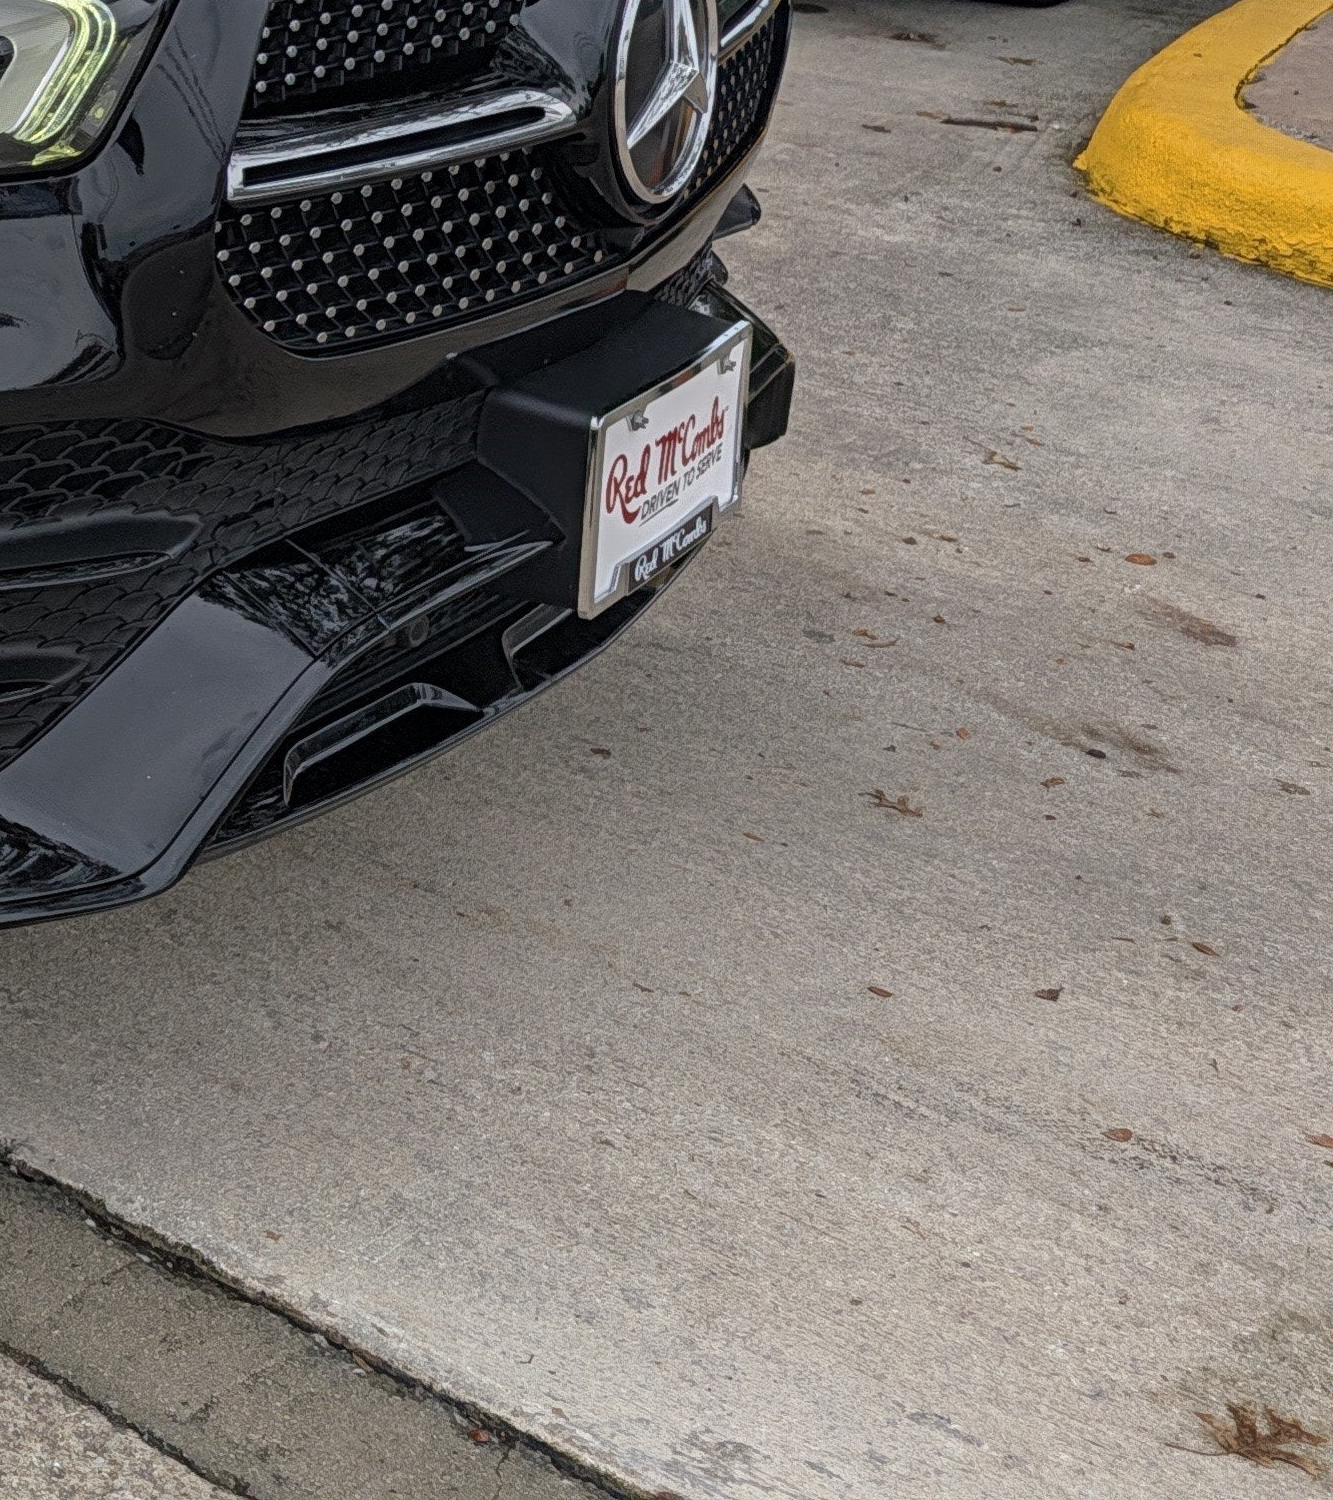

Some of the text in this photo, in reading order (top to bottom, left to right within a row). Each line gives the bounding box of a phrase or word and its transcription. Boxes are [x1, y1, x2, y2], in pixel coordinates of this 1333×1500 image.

[605, 395, 725, 524] Red McCombs
[641, 443, 723, 520] DRIVEN TO SERVE
[634, 545, 659, 583] Red
